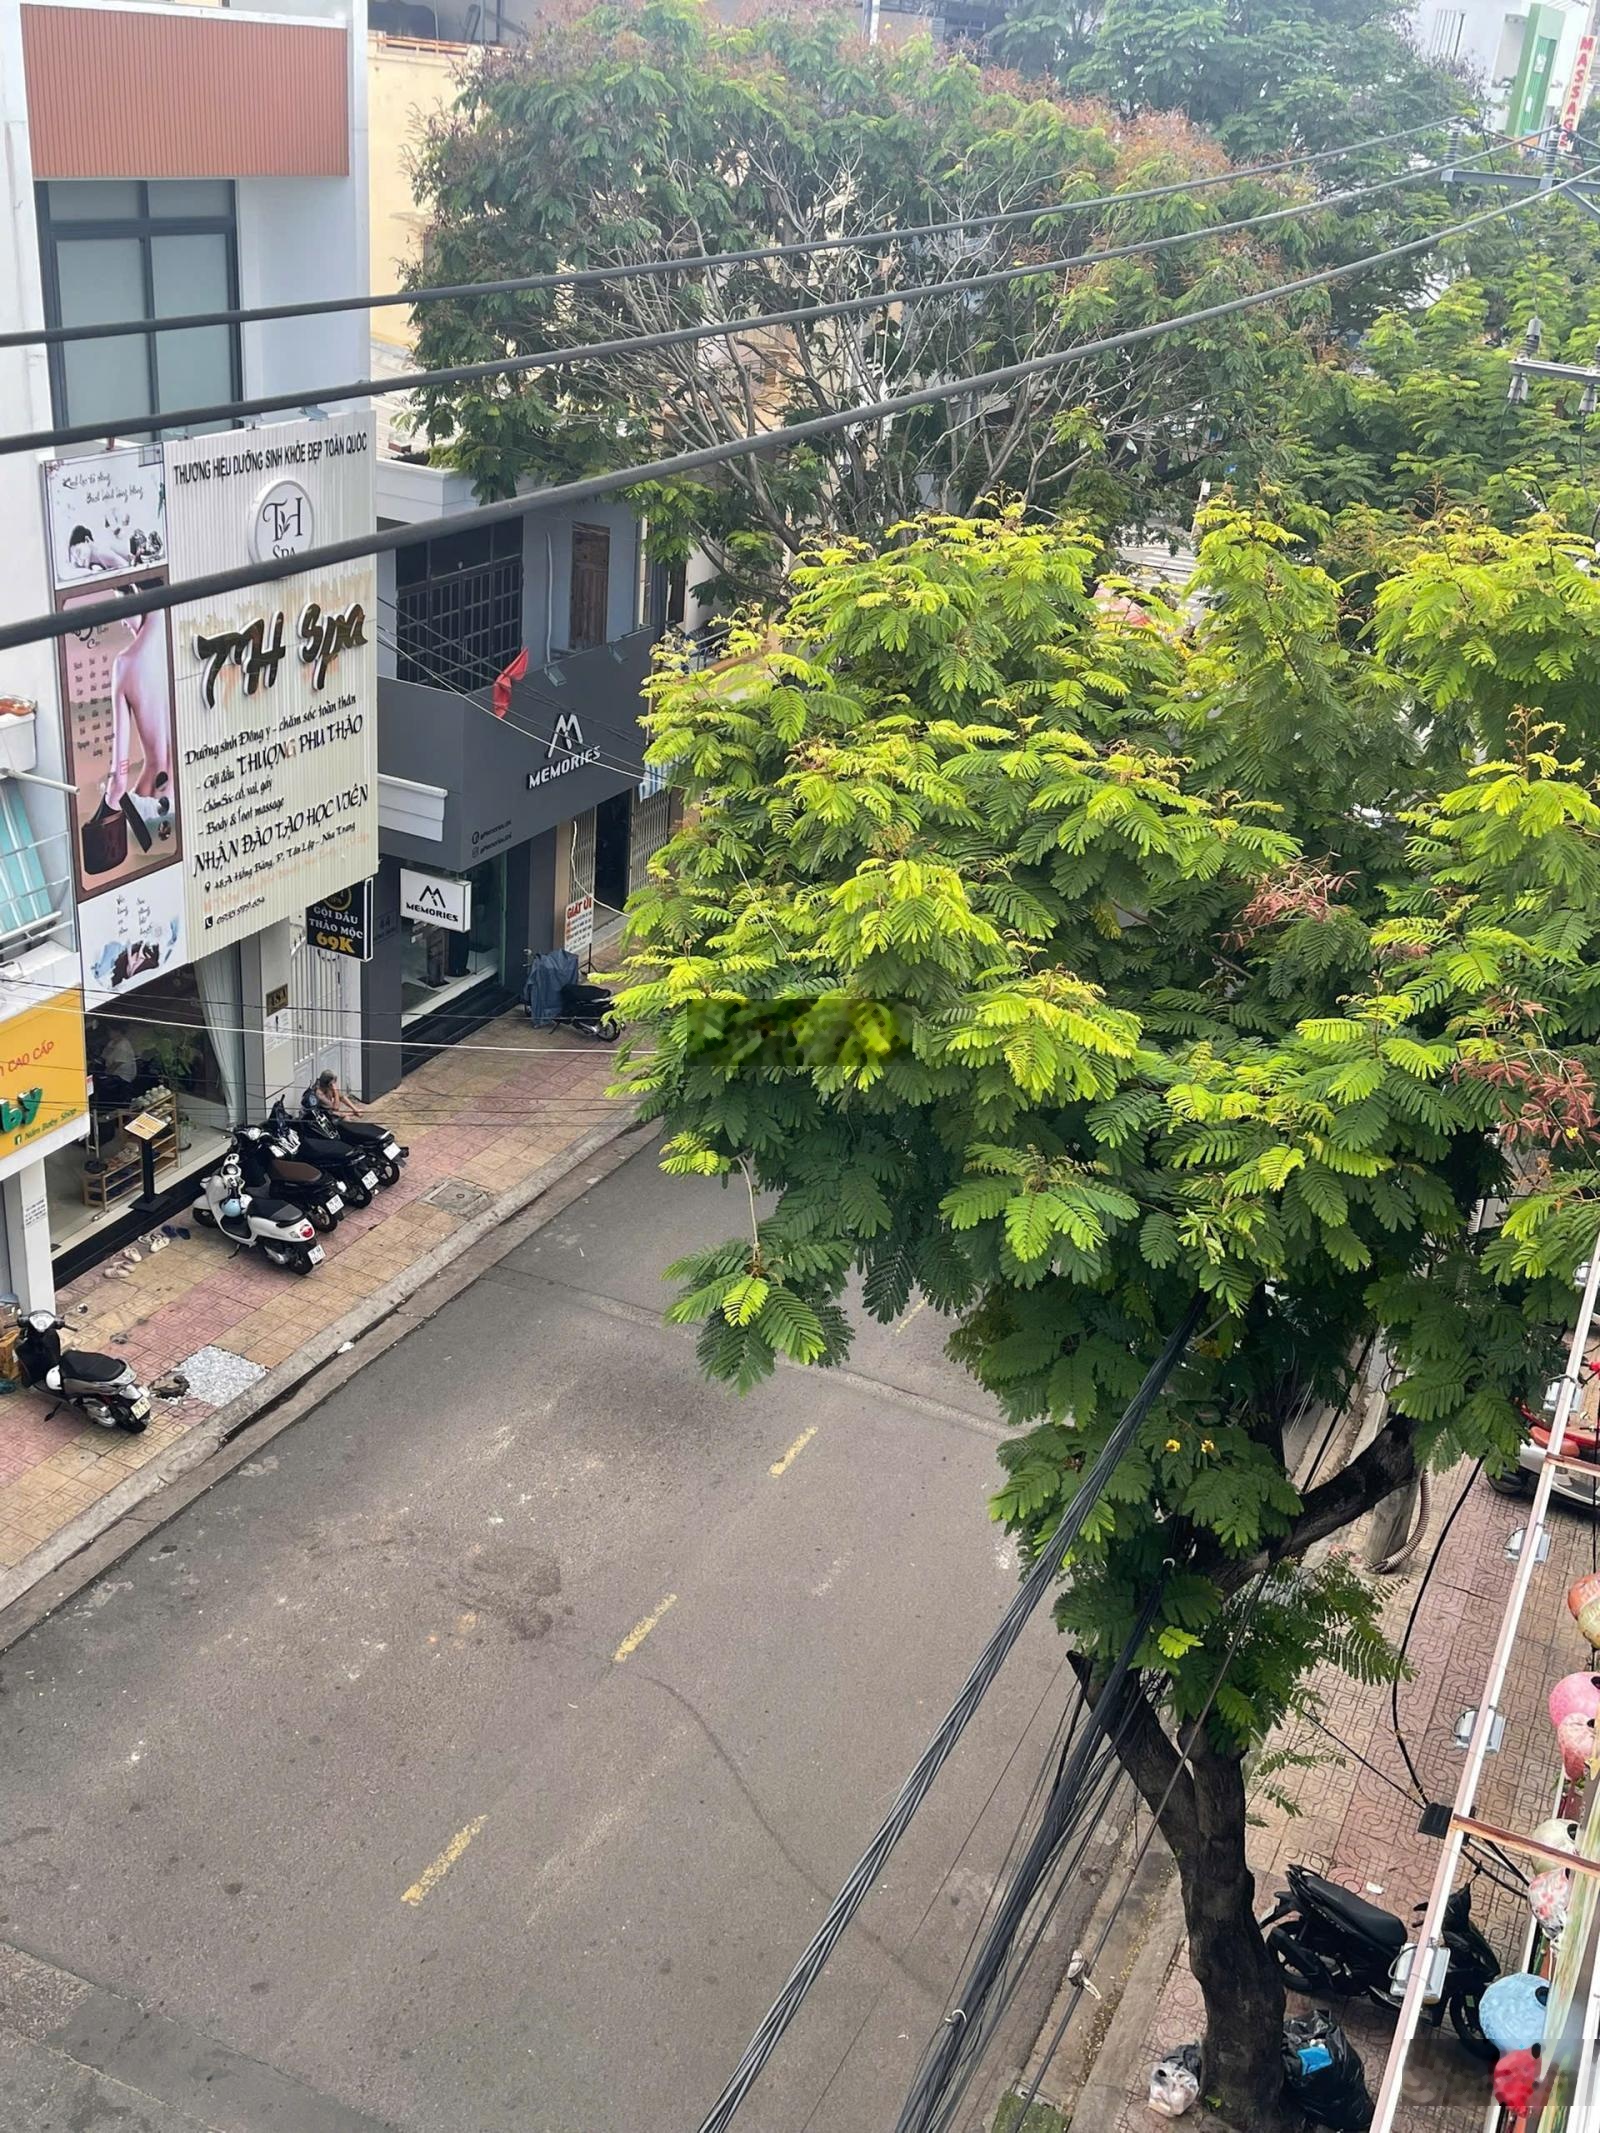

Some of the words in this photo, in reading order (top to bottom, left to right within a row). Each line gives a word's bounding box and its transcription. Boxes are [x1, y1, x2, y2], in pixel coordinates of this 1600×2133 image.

[1559, 36, 1594, 147] MASSAGE
[173, 460, 211, 485] THƯƠNG
[213, 455, 232, 483] HIỆU
[233, 449, 264, 475] DƯỠNG
[265, 446, 283, 469] SINH
[307, 440, 322, 464] ĐẸP
[324, 433, 345, 457] TOÀN
[346, 431, 367, 454] QUỐC
[192, 611, 286, 709] TH
[299, 603, 368, 690] Spa
[220, 735, 237, 753] sinh
[279, 714, 302, 732] chăm
[302, 705, 317, 722] sóc
[318, 700, 337, 718] toàn
[236, 738, 297, 776] THƯỢNG
[527, 745, 600, 789] MEMORIES
[193, 838, 240, 877] NHẬN
[241, 824, 273, 855] ĐÀO
[275, 812, 304, 840] TẠO
[306, 799, 334, 827] HỌC
[206, 816, 228, 835] Body
[254, 797, 284, 816] massage
[406, 902, 459, 922] MEMORIES
[316, 931, 355, 953] 69K
[8, 1053, 30, 1072] CAO
